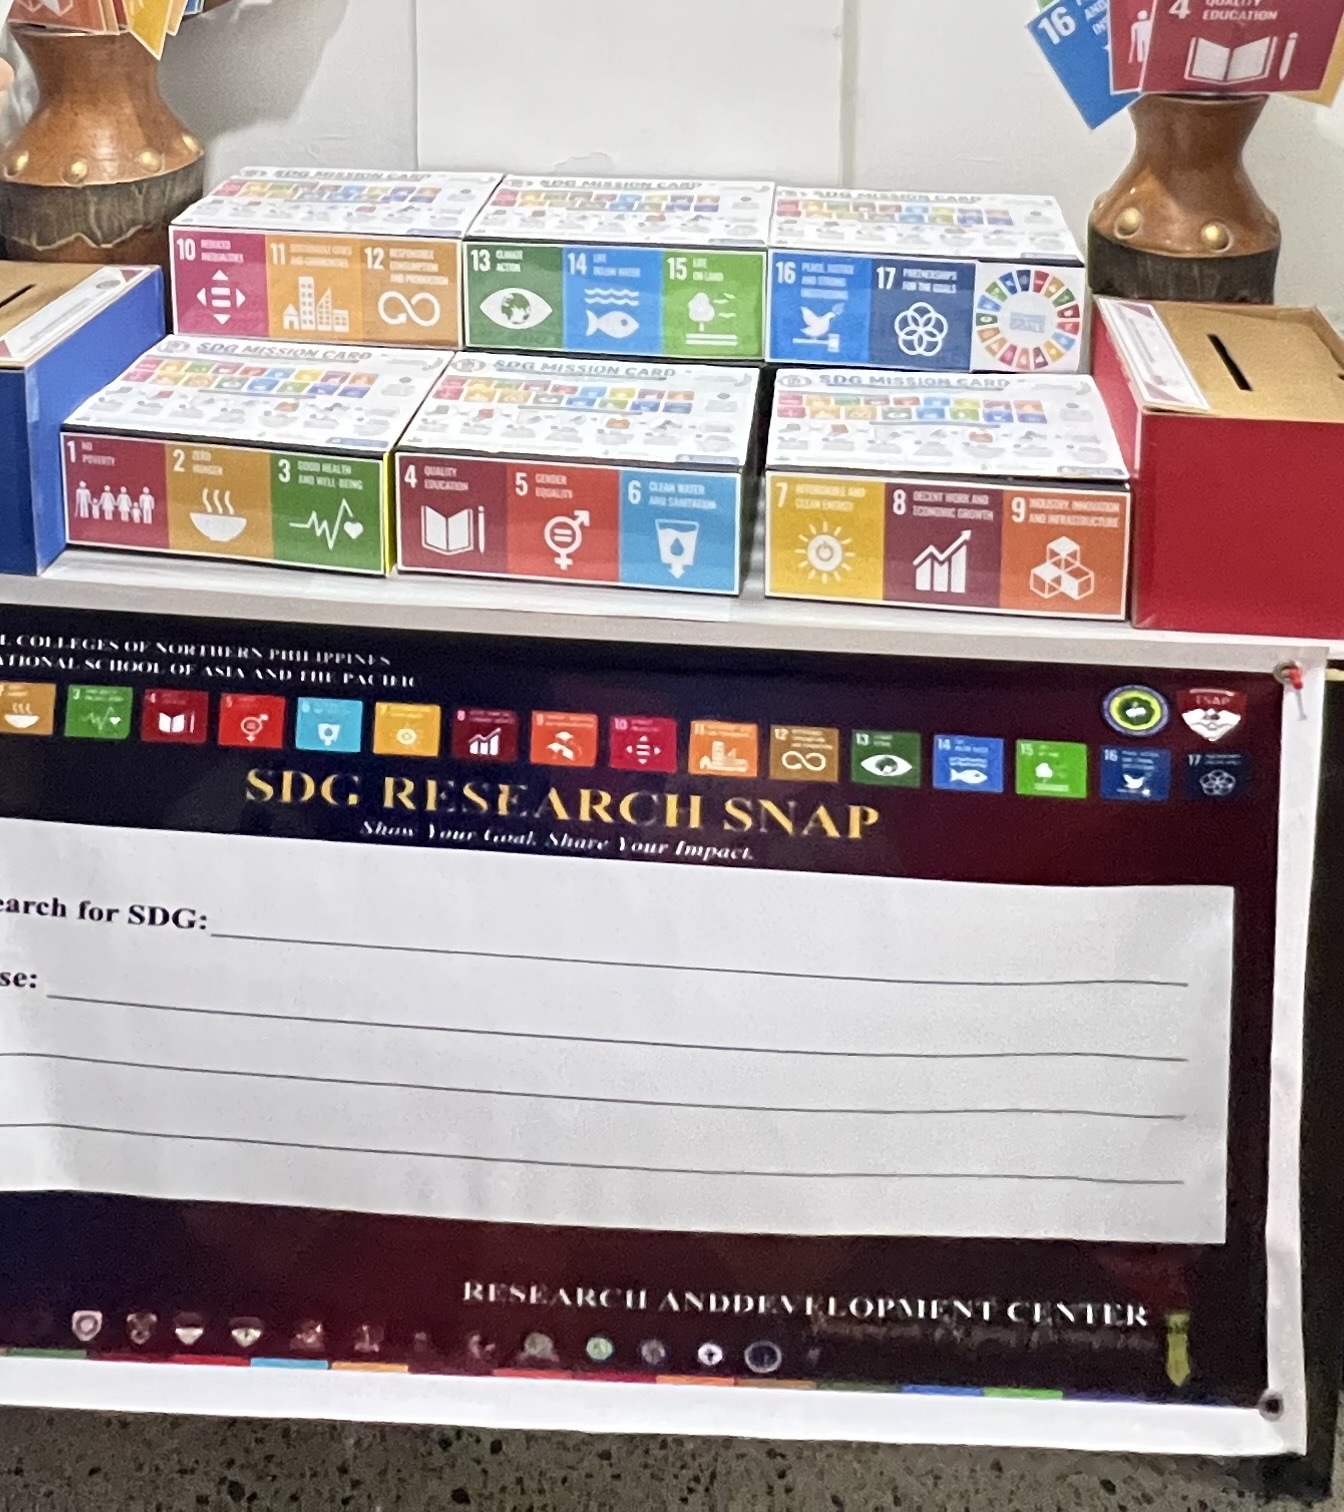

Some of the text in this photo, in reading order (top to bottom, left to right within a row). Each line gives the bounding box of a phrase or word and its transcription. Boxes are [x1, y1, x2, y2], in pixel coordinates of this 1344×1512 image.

[1038, 7, 1076, 45] 16
[1202, 9, 1278, 22] EDUCATION
[177, 239, 195, 260] 10
[270, 243, 285, 264] 11
[364, 247, 384, 269] 12
[471, 249, 491, 272] 13
[568, 253, 587, 275] 14
[667, 257, 687, 280] 15
[776, 261, 796, 284] 16
[876, 266, 896, 290] 17
[197, 342, 372, 360] SDG MISSION CARD
[493, 359, 676, 377] SDG MISSION CARD
[819, 374, 1010, 387] SDG MISSION CARD
[67, 440, 76, 463] 1
[82, 454, 115, 467] POVERTY
[172, 448, 186, 472] 2
[278, 458, 291, 483] 3
[404, 464, 418, 488] 4
[423, 465, 457, 477] QUALITY
[515, 472, 528, 497] 5
[628, 480, 641, 504] 6
[776, 482, 788, 509] 7
[893, 489, 906, 515] 8
[1011, 496, 1026, 523] 9
[16, 634, 119, 650] COLLEGES
[124, 640, 150, 653] OF
[156, 642, 263, 659] NORTHERN
[269, 648, 391, 665] PHILIPPINES
[85, 658, 164, 674] SCHOOL
[170, 662, 193, 676] OF
[205, 665, 246, 678] ASIA
[254, 668, 292, 681] AND
[299, 670, 333, 683] THE
[341, 672, 415, 688] PACIFIC
[774, 728, 788, 741] 12
[855, 732, 871, 747] 13
[937, 737, 951, 752] 14
[1019, 742, 1034, 757] 15
[1103, 748, 1119, 762] 16
[1187, 753, 1201, 768] 17
[245, 767, 881, 841] SDG RESEARCH SNAP
[360, 821, 755, 861] Show Your Goal. Share Your Impact.
[77, 900, 119, 923] for
[127, 904, 208, 931] SDG:
[462, 1281, 648, 1310] RESEARCH
[1006, 1301, 1148, 1326] CENTER
